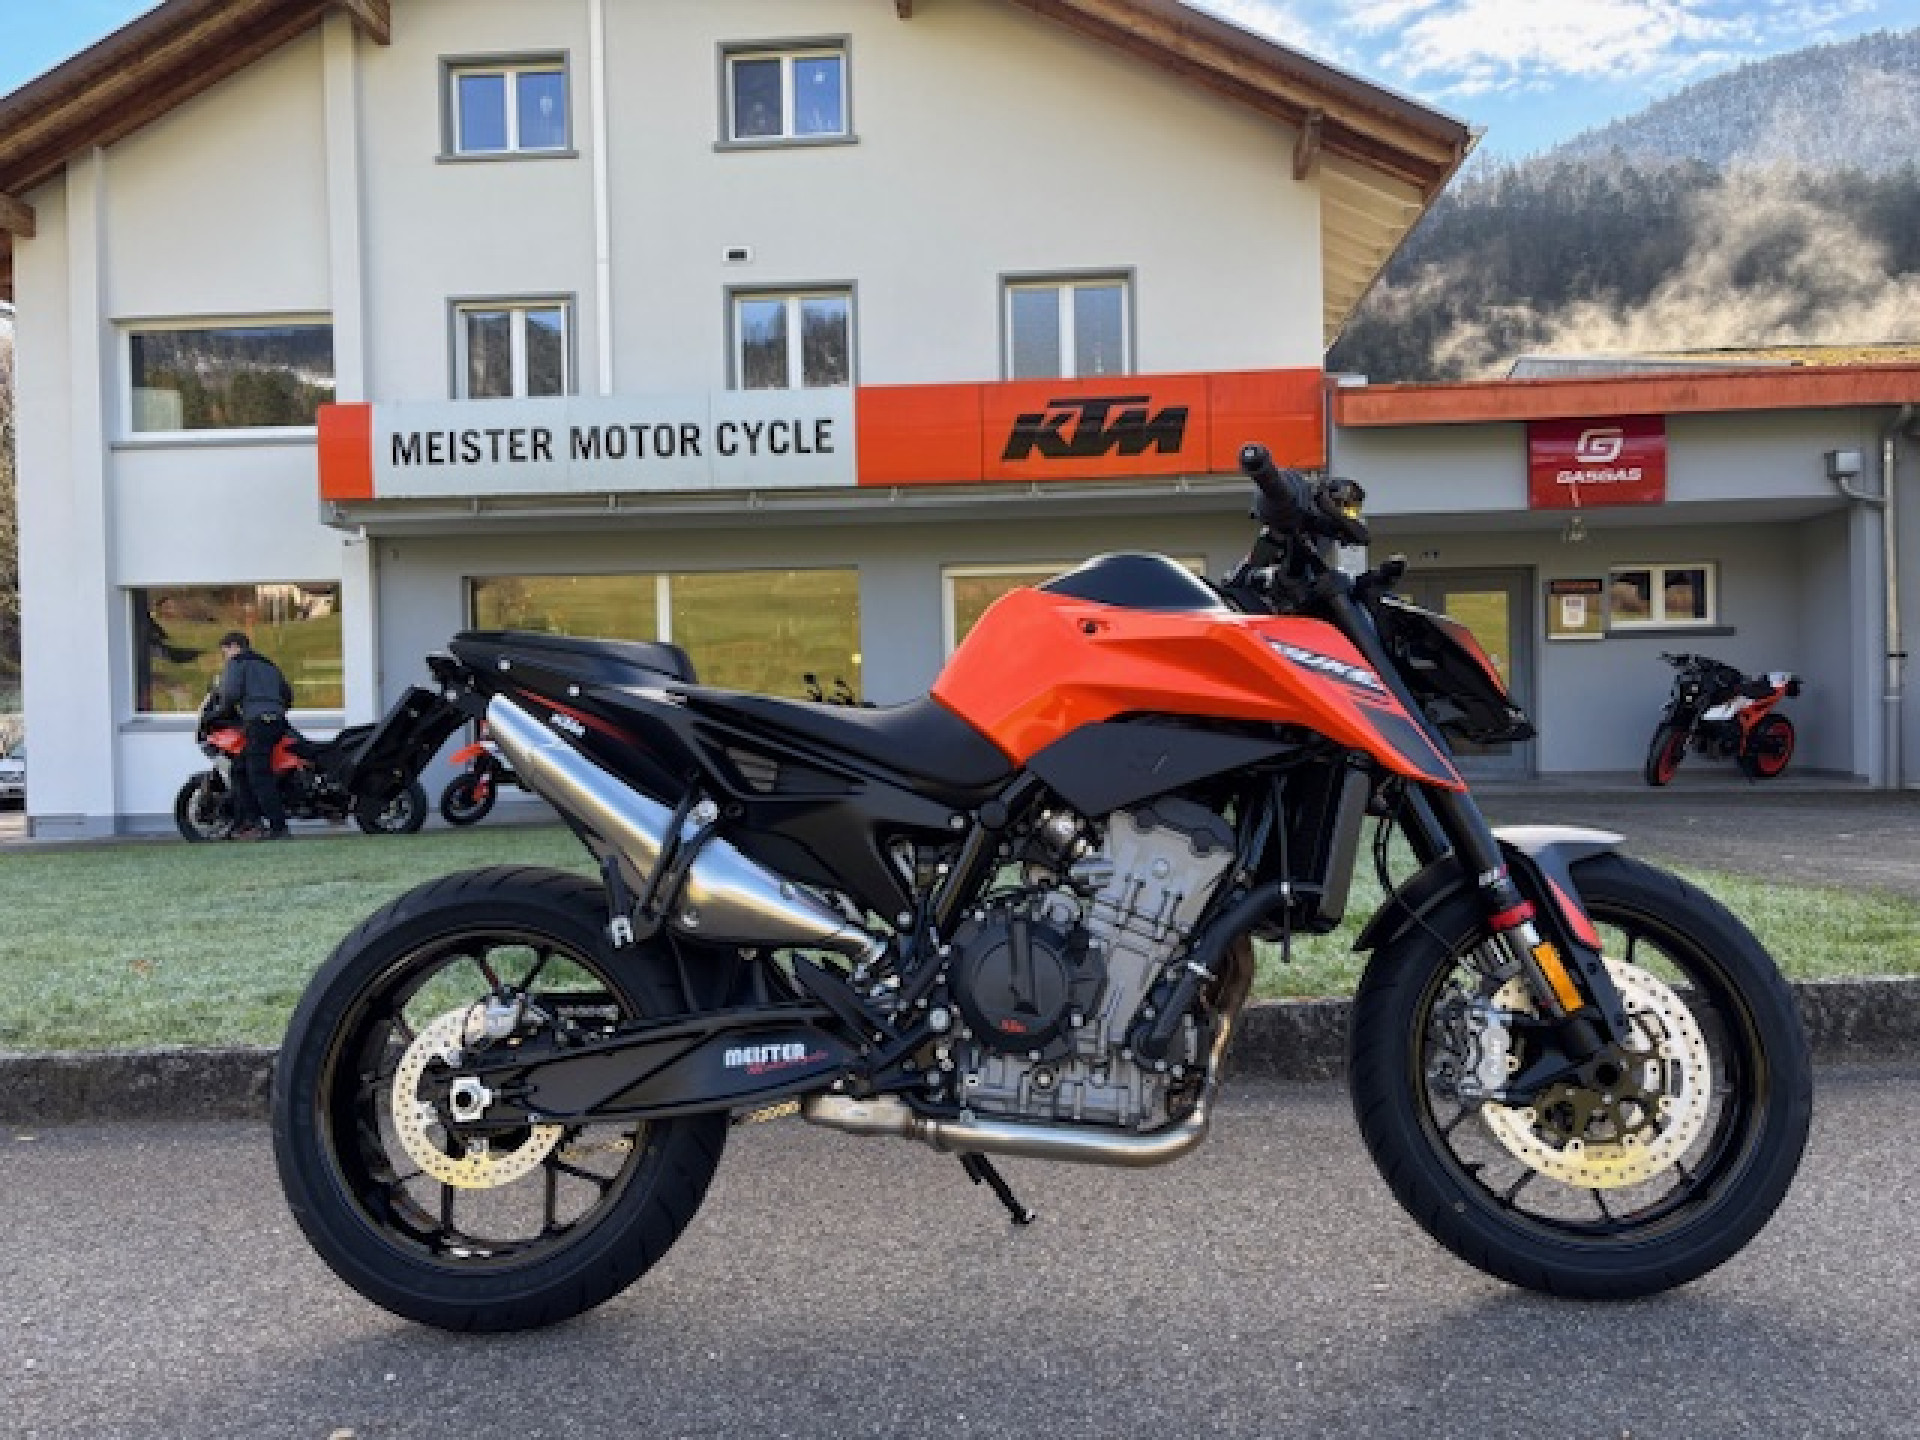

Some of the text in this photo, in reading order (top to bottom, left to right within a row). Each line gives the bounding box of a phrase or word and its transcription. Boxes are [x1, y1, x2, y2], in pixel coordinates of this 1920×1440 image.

[391, 419, 835, 466] MEISTER MOTOR CYCLE
[1001, 395, 1189, 462] KTM
[1556, 467, 1642, 484] GASGAS
